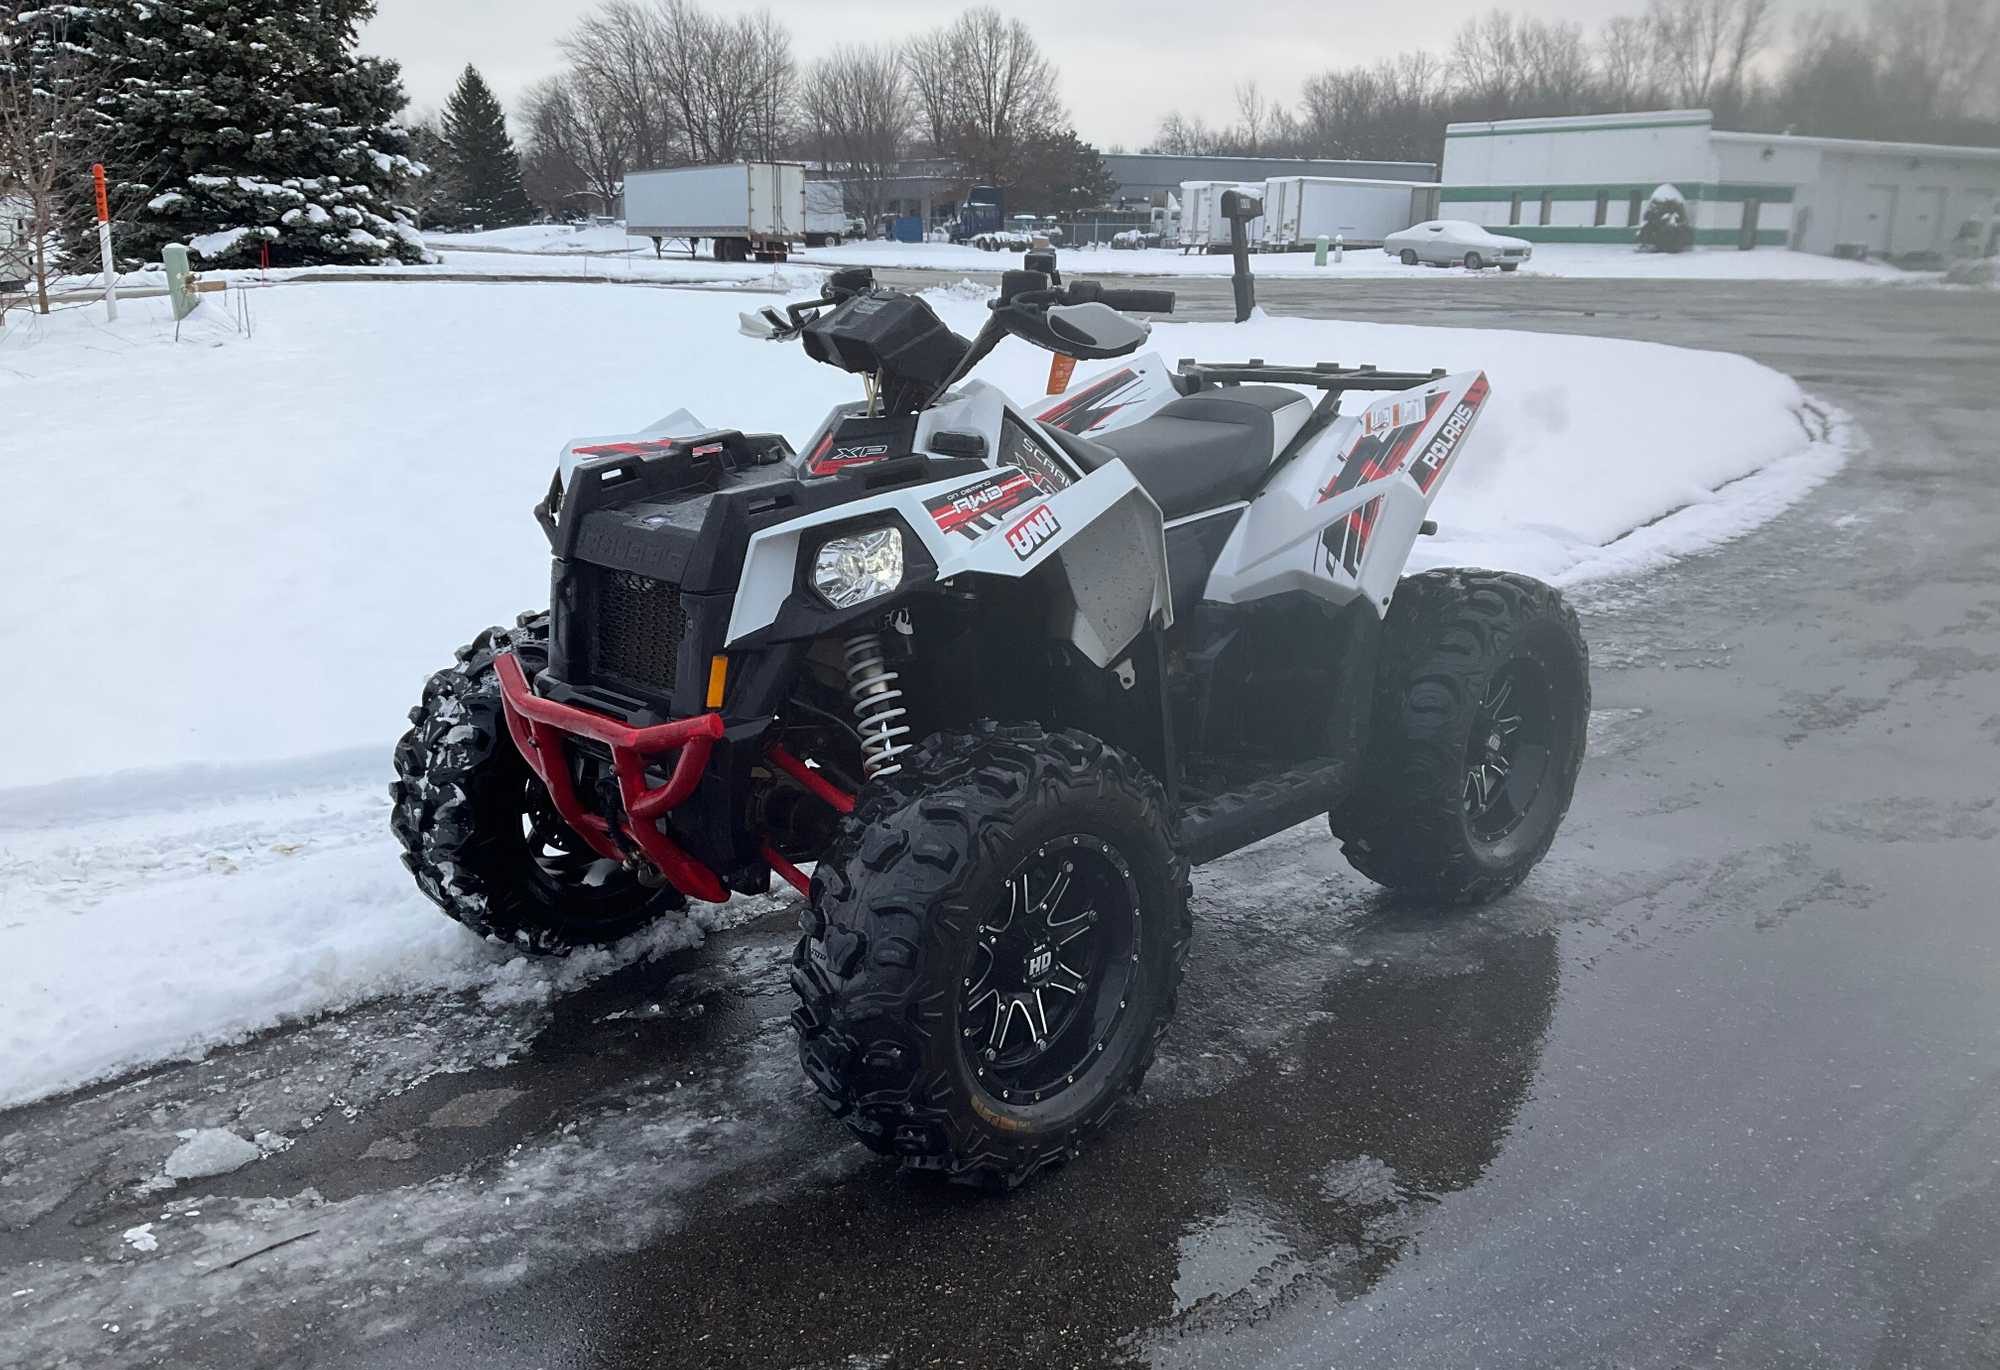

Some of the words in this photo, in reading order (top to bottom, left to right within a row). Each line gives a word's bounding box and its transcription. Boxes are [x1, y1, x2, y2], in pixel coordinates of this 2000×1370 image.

[1422, 403, 1473, 470] POLARIS
[832, 444, 888, 460] XP
[952, 486, 1003, 514] AWD
[1011, 508, 1059, 556] UNI
[1028, 951, 1052, 976] HD
